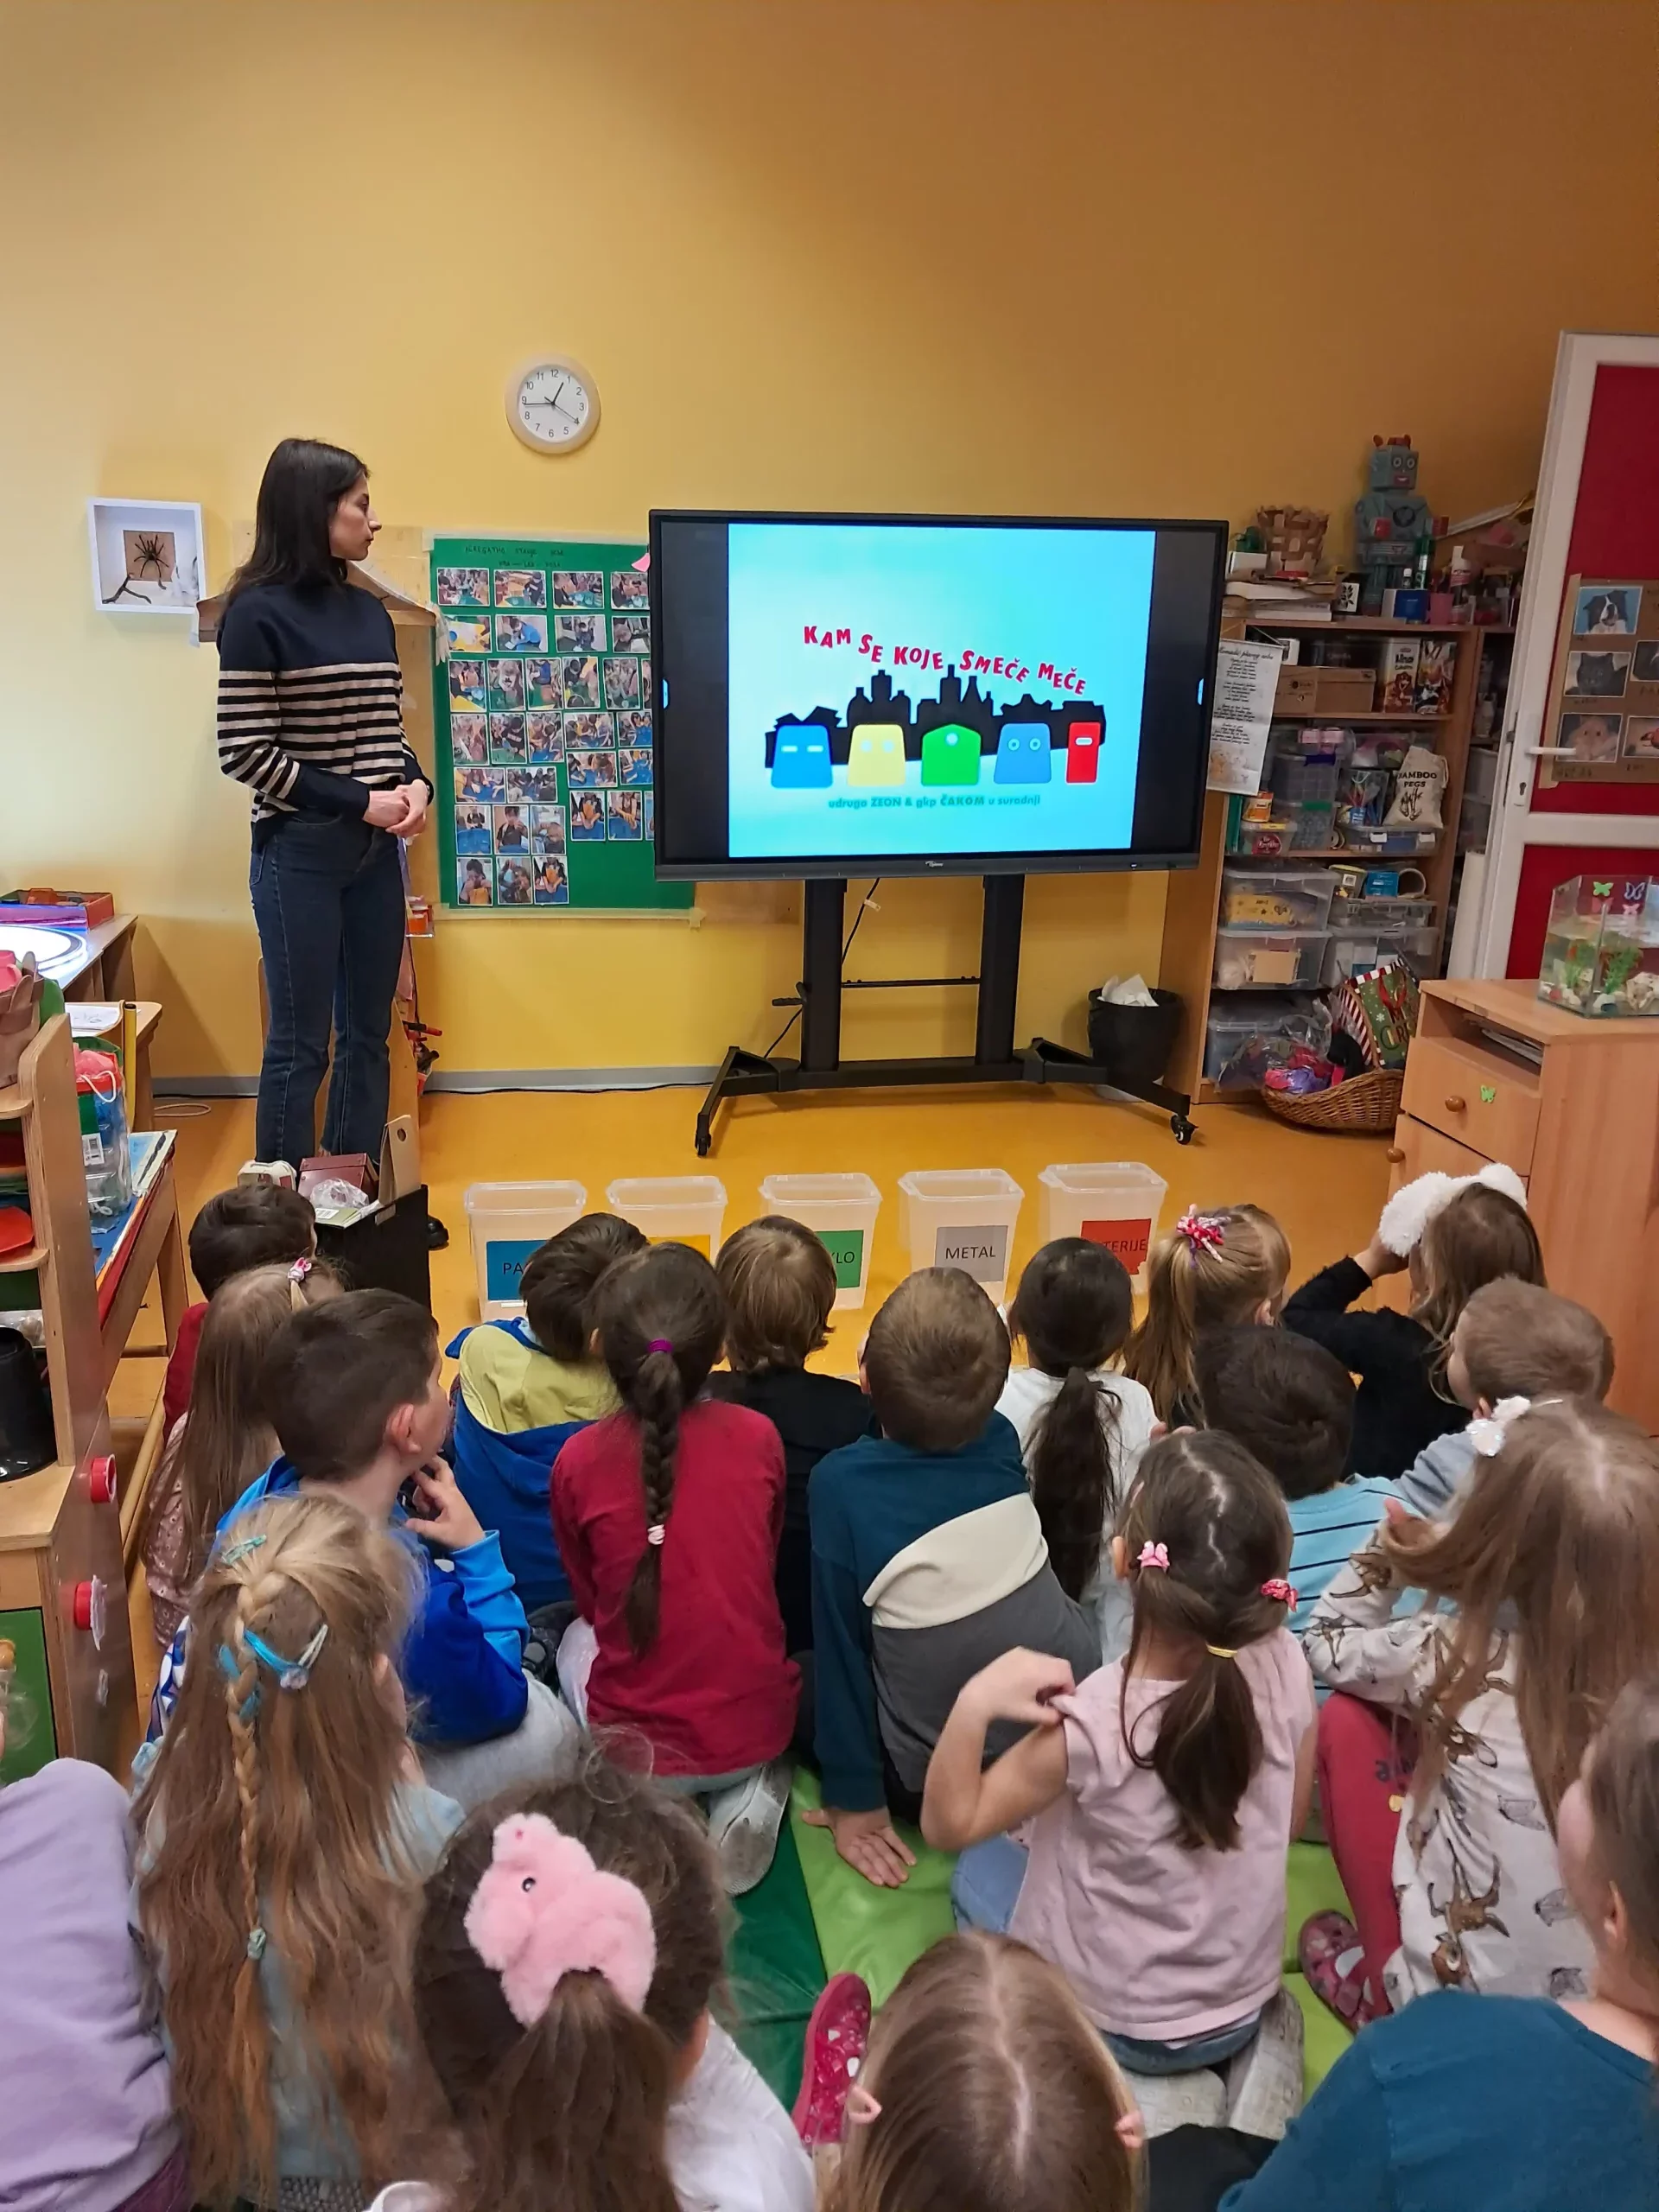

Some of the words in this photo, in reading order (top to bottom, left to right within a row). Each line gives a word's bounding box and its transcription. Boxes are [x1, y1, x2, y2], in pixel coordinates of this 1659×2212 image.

[537, 372, 544, 380] 11
[550, 369, 559, 378] 12
[567, 375, 570, 384] 1
[525, 381, 534, 390] 10
[575, 387, 582, 396] 2
[521, 396, 527, 405] 9
[579, 403, 585, 411] 3
[524, 411, 531, 420] 8
[804, 626, 851, 648] KAM
[858, 633, 883, 663] SE
[893, 646, 944, 671] KOJE
[959, 650, 1030, 683] SMEČE
[1038, 662, 1086, 695] MEČE
[828, 797, 868, 810] udruga
[870, 796, 902, 807] ZEON
[905, 797, 913, 806] &
[916, 796, 937, 810] gkp
[940, 793, 985, 806] ČAKOM
[997, 794, 1040, 806] suradnji
[1103, 1239, 1147, 1253] TERIJE
[945, 1245, 996, 1259] METAL
[503, 1262, 524, 1275] PA
